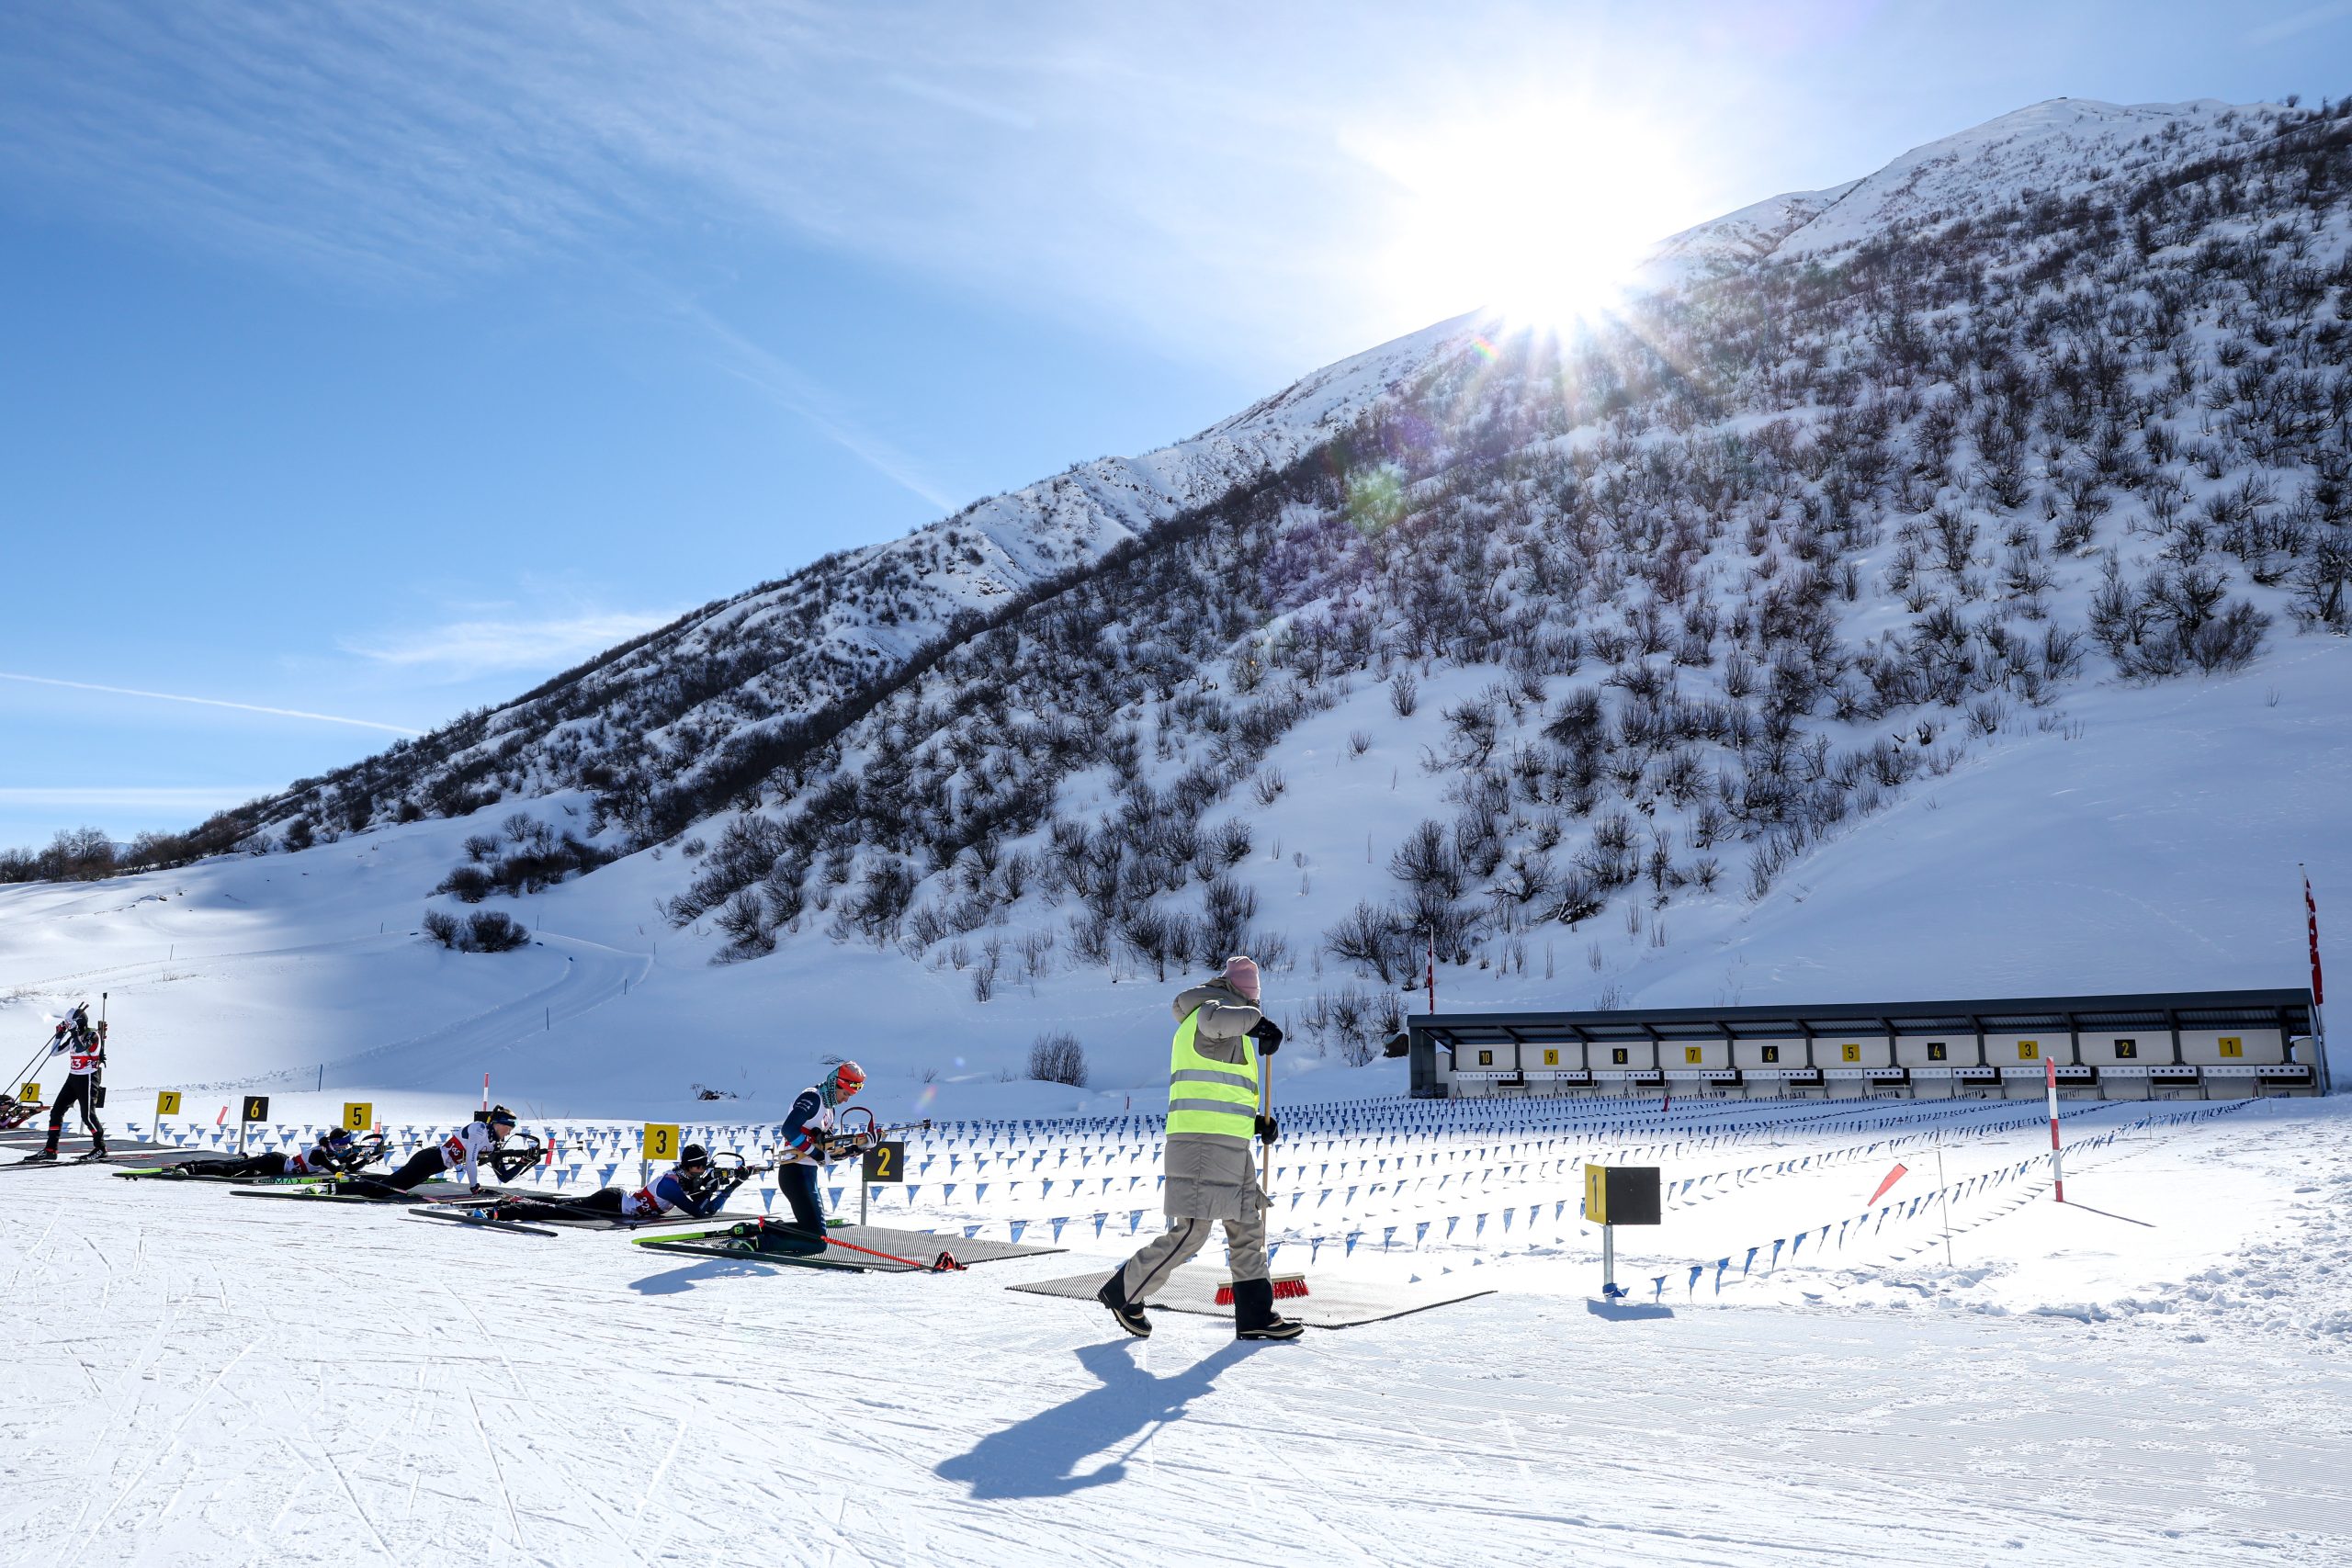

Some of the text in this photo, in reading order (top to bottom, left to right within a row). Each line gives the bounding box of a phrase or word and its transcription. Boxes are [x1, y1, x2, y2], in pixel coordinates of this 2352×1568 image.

[1848, 1046, 1854, 1059] 5
[1933, 1045, 1940, 1058] 4
[2025, 1043, 2032, 1056] 3
[2121, 1043, 2130, 1055] 2
[2227, 1040, 2233, 1054] 1
[1481, 1052, 1489, 1064] 10
[1549, 1051, 1554, 1063] 9
[1617, 1050, 1623, 1062] 8
[1690, 1049, 1696, 1061] 7
[1767, 1048, 1773, 1061] 6
[27, 1086, 33, 1100] 9
[165, 1095, 173, 1111] 7
[251, 1100, 259, 1118] 6
[353, 1108, 362, 1125] 5
[656, 1130, 667, 1155] 3
[877, 1147, 890, 1176] 2
[1592, 1174, 1598, 1213] 1
